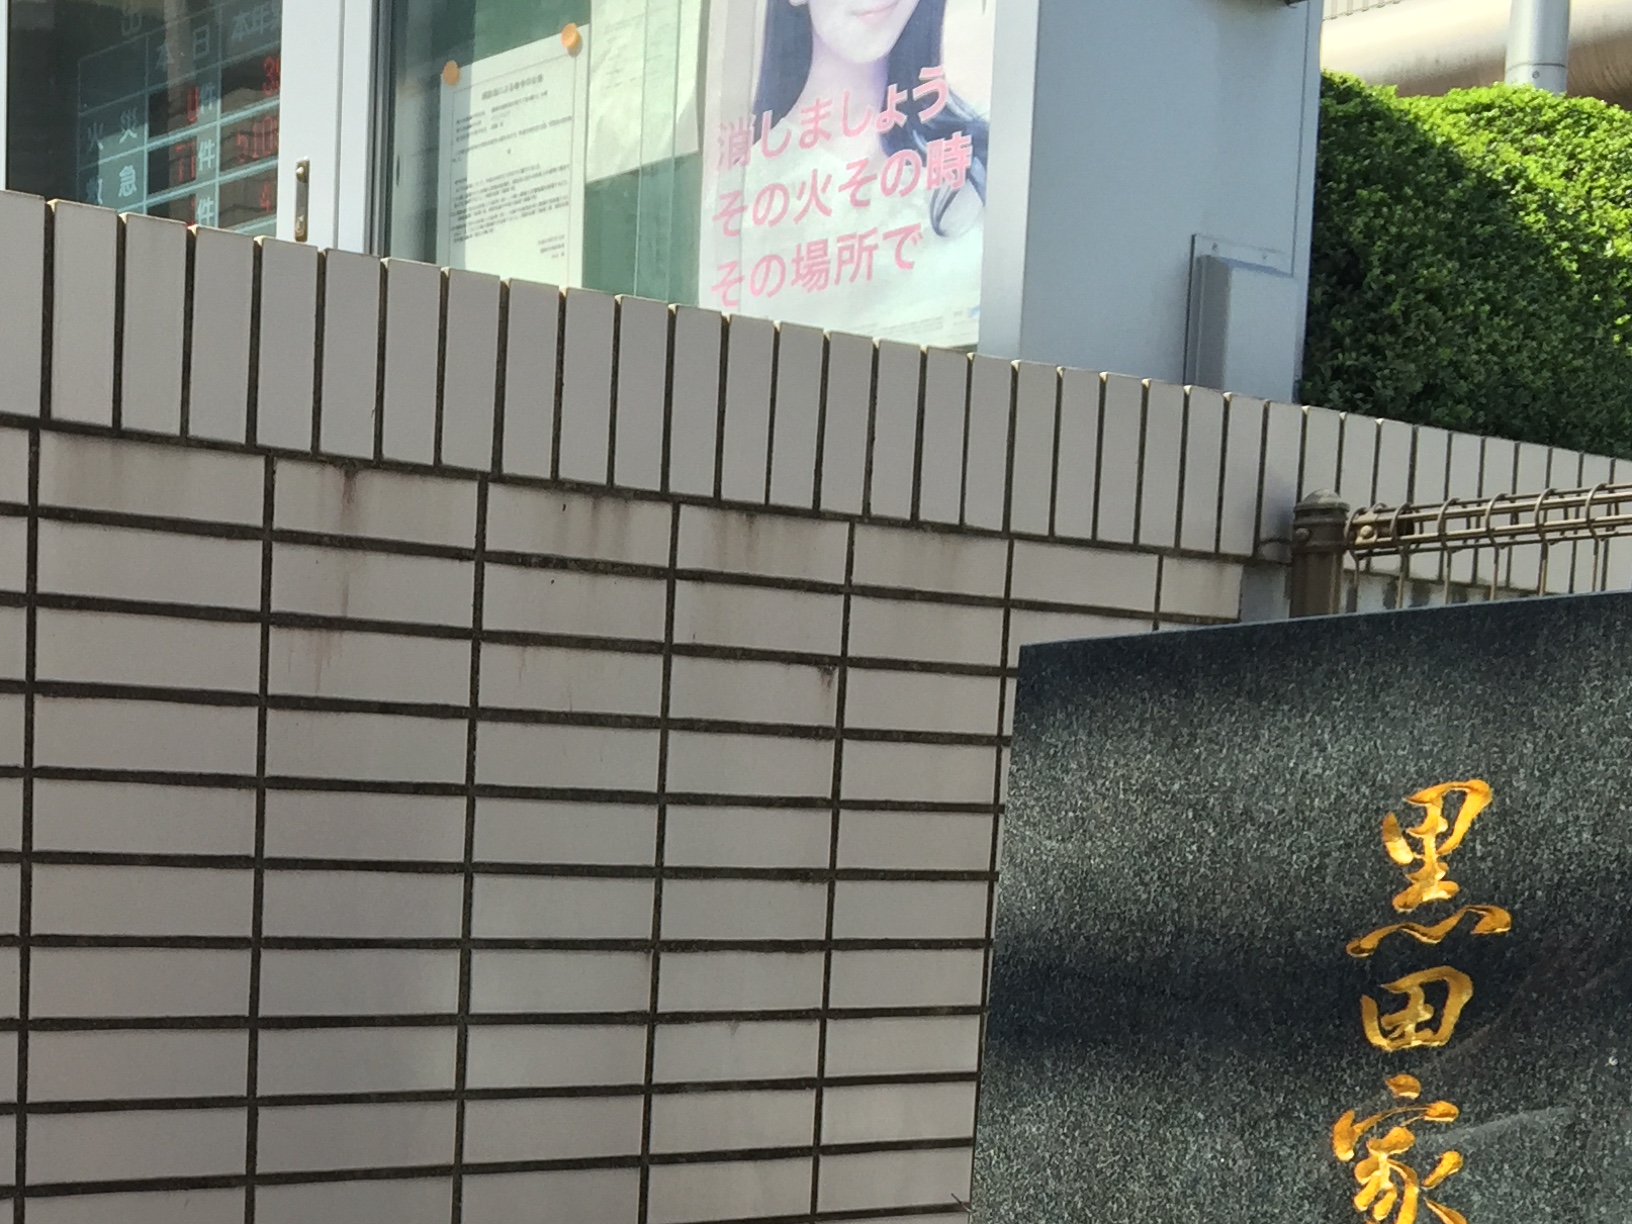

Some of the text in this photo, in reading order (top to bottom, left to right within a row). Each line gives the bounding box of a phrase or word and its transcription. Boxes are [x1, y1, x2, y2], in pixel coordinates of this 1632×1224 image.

[718, 65, 949, 171] 消しましょう
[712, 131, 973, 238] その火その時
[711, 223, 923, 307] その場所で
